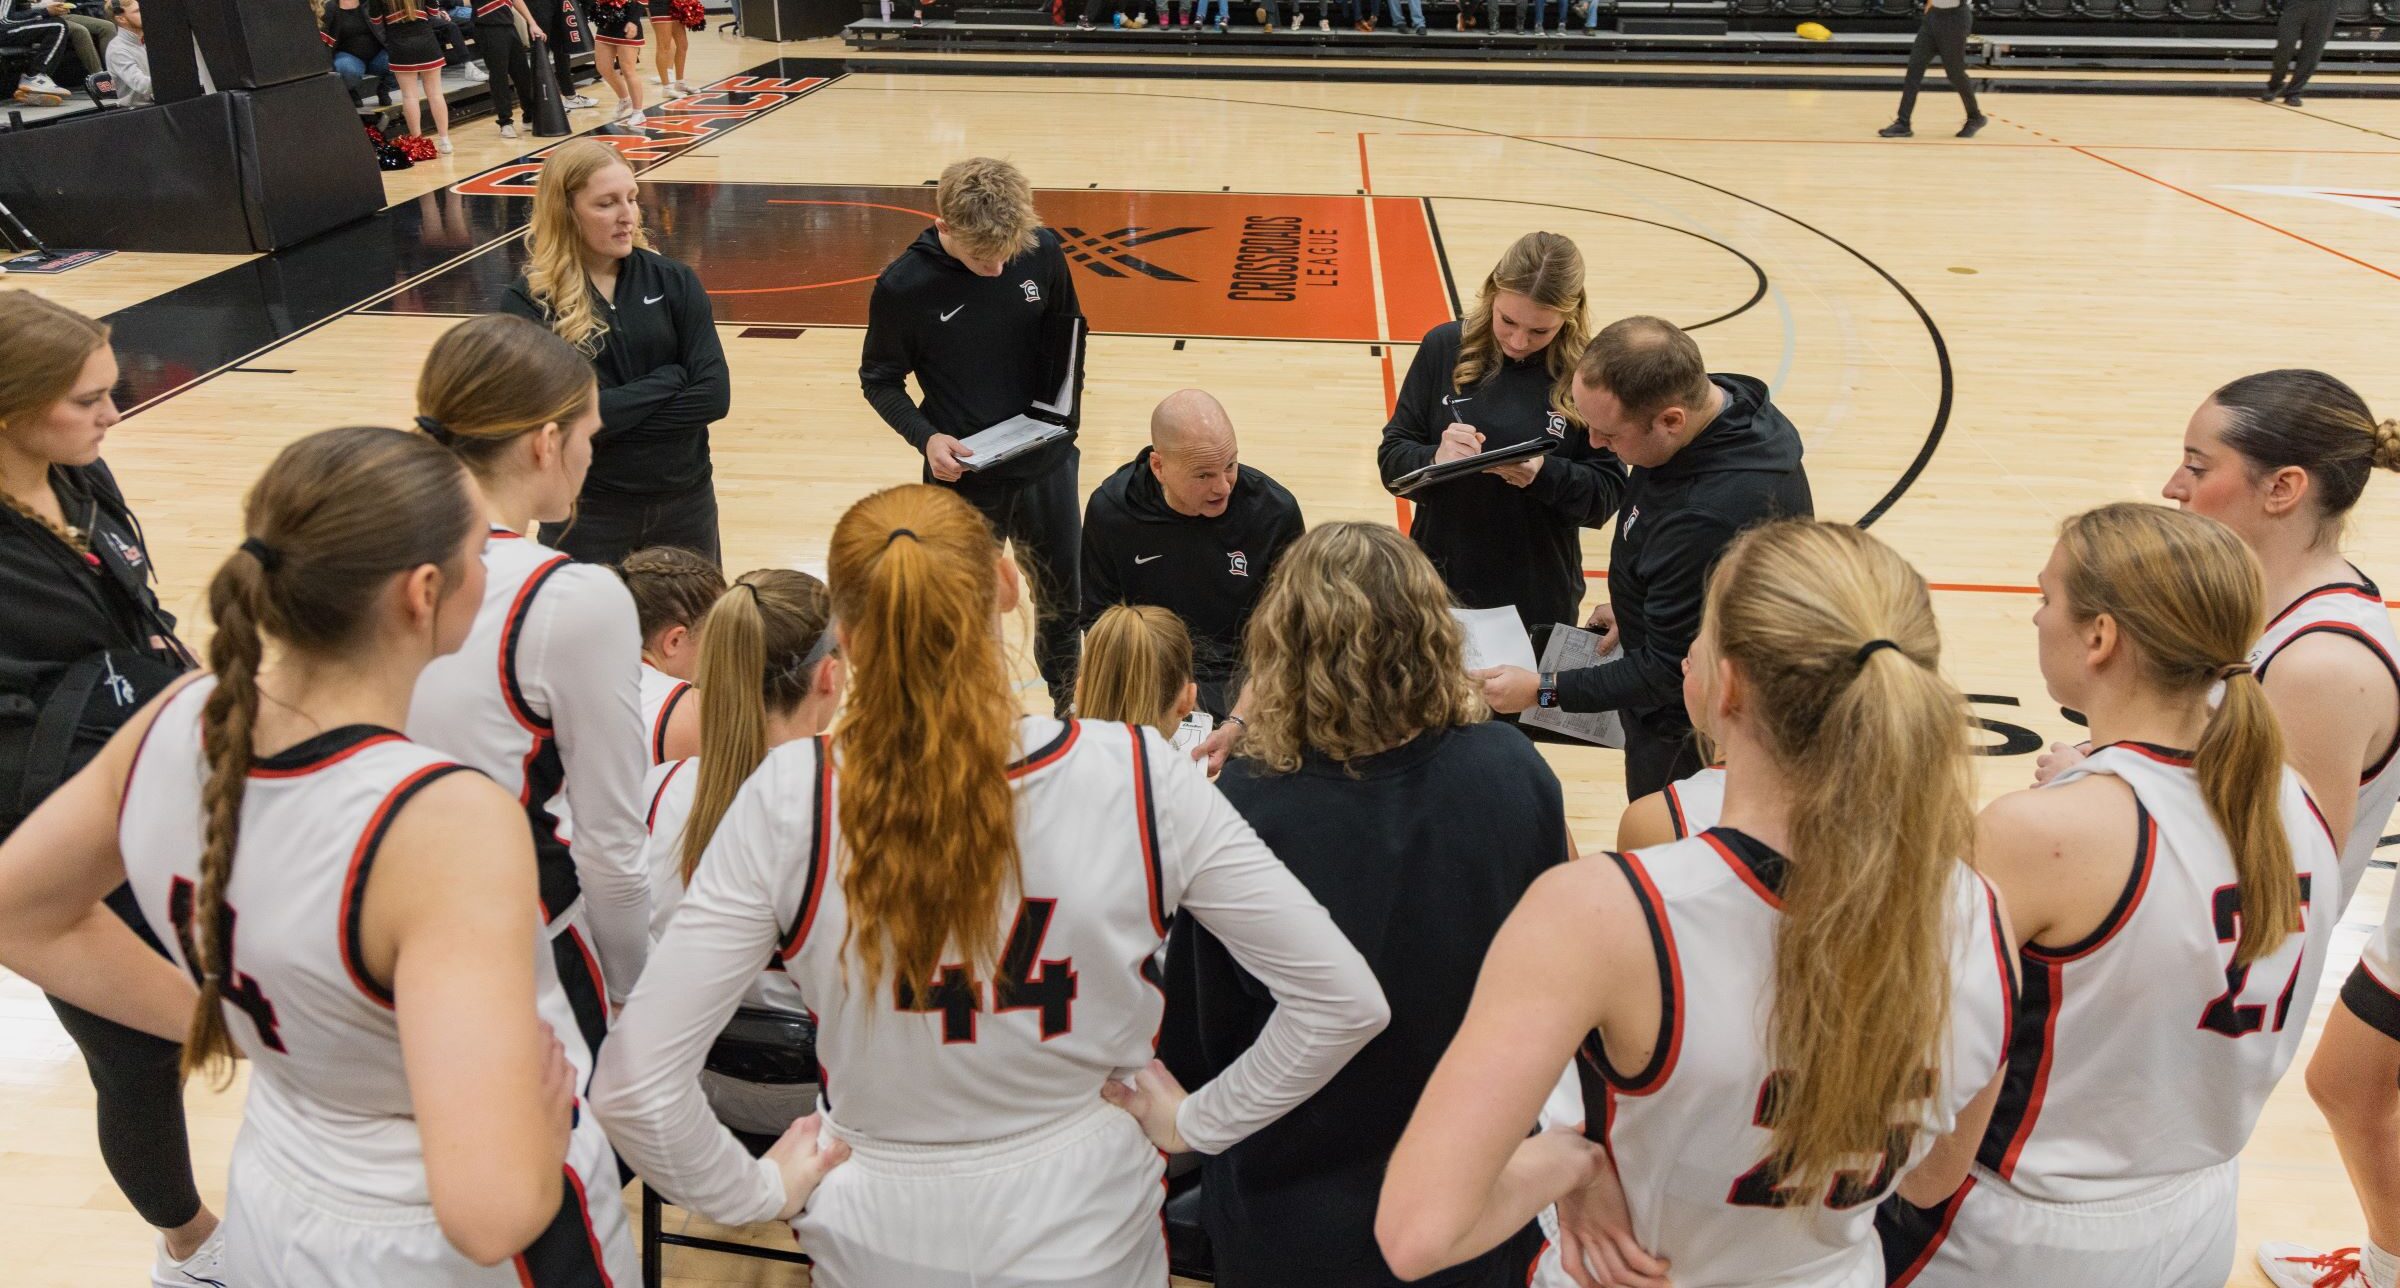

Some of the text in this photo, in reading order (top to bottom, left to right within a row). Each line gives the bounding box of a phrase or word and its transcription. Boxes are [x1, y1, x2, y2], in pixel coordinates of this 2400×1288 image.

[1227, 215, 1303, 301] CROSSROADS
[1305, 228, 1338, 287] LEAGUE
[892, 897, 1078, 1045] 44
